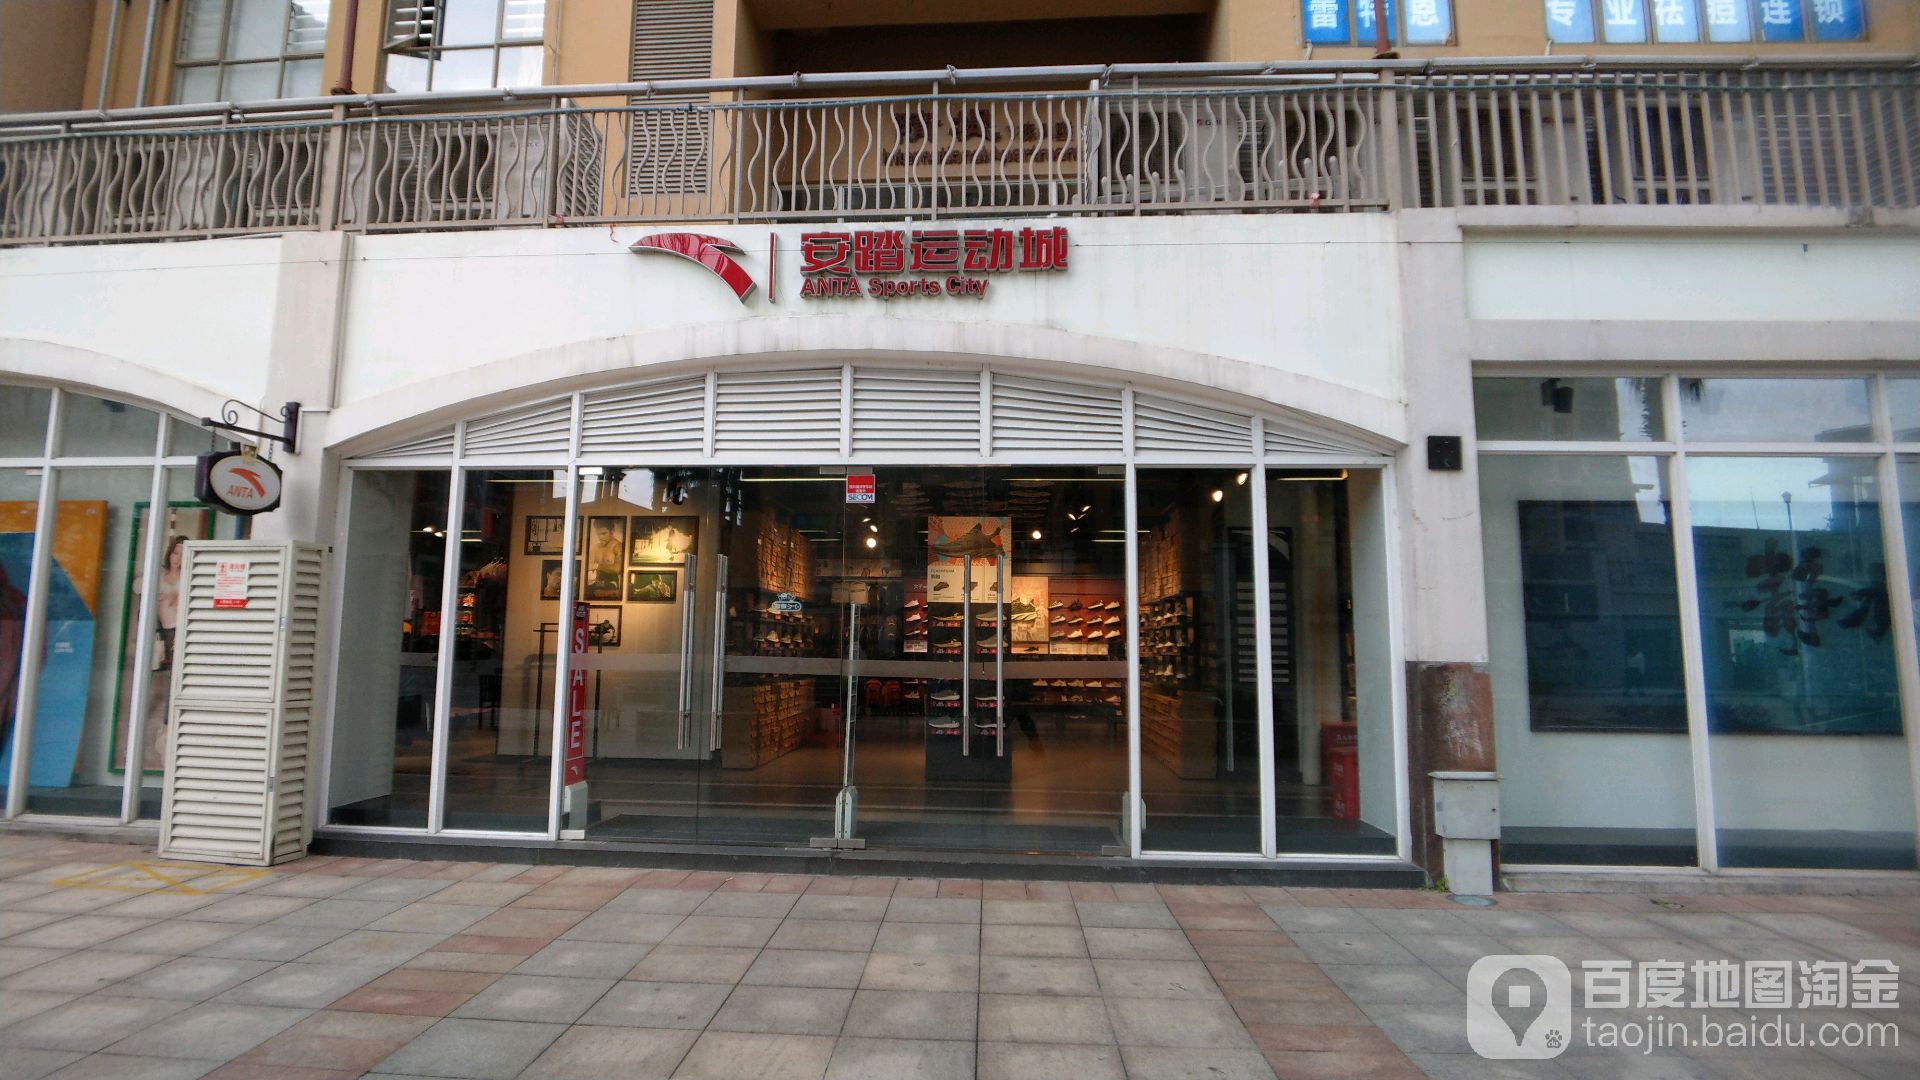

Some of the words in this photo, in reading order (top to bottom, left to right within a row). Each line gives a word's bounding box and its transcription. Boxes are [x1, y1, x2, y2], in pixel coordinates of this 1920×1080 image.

[801, 227, 1068, 273] 安踏运动城
[801, 276, 860, 297] ANTA
[867, 277, 941, 299] Sports
[945, 274, 989, 299] City
[226, 485, 254, 499] ANTA
[848, 493, 874, 501] SECOM
[570, 627, 585, 749] SALE
